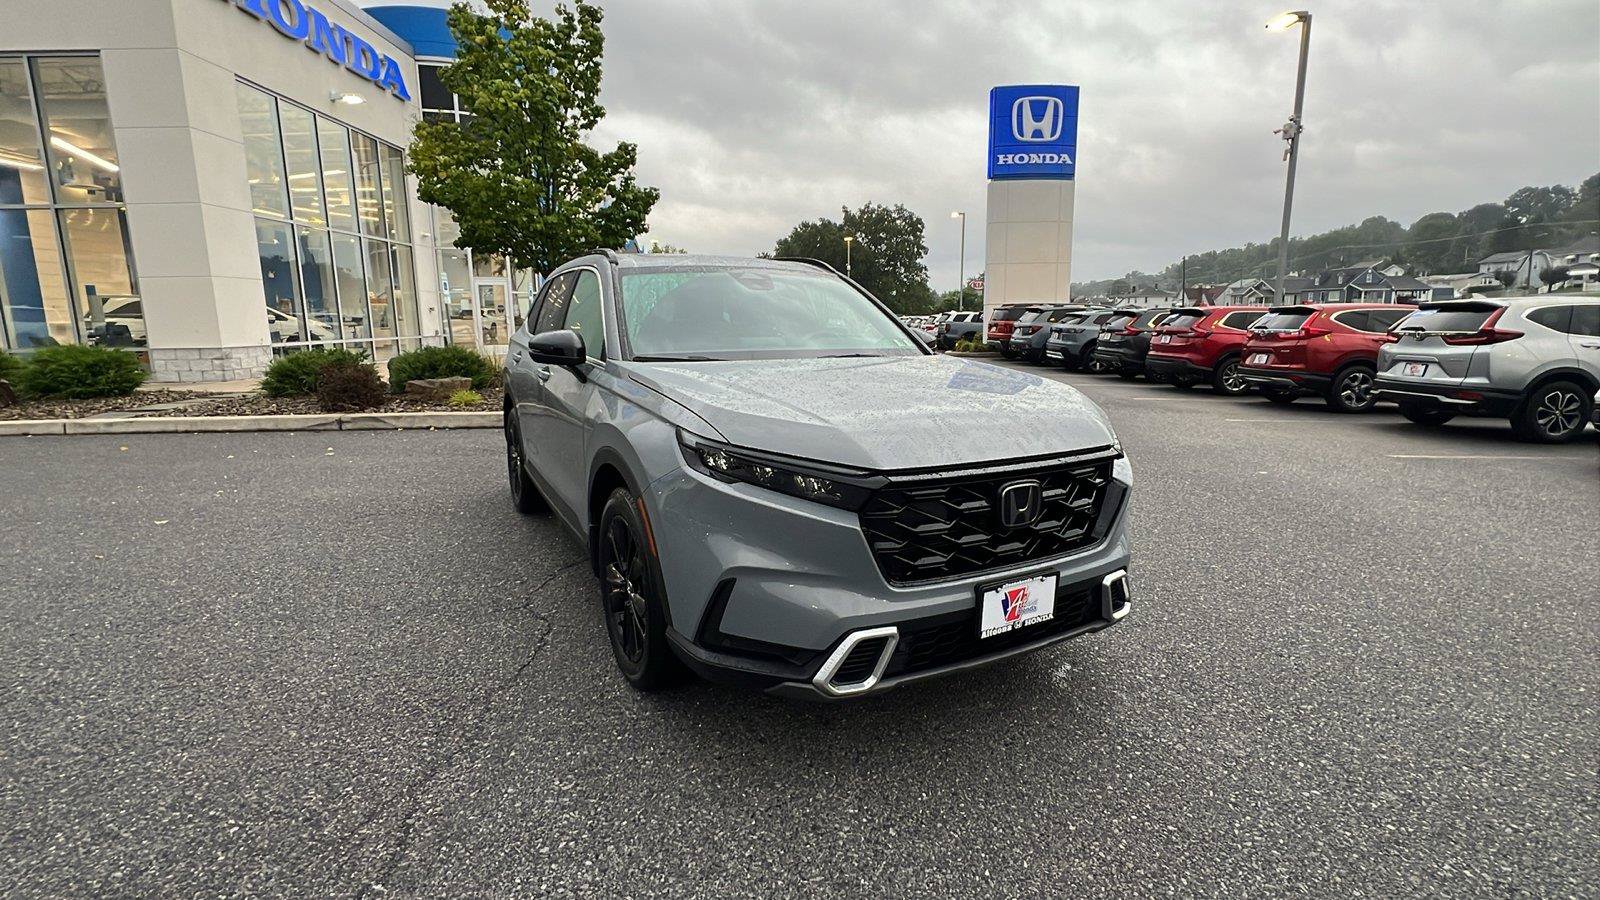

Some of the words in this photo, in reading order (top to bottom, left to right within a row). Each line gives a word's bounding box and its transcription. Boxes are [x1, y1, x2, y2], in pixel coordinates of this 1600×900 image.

[997, 153, 1072, 165] HONDA
[981, 625, 1012, 639] Altoona
[1024, 612, 1054, 627] HONDA
